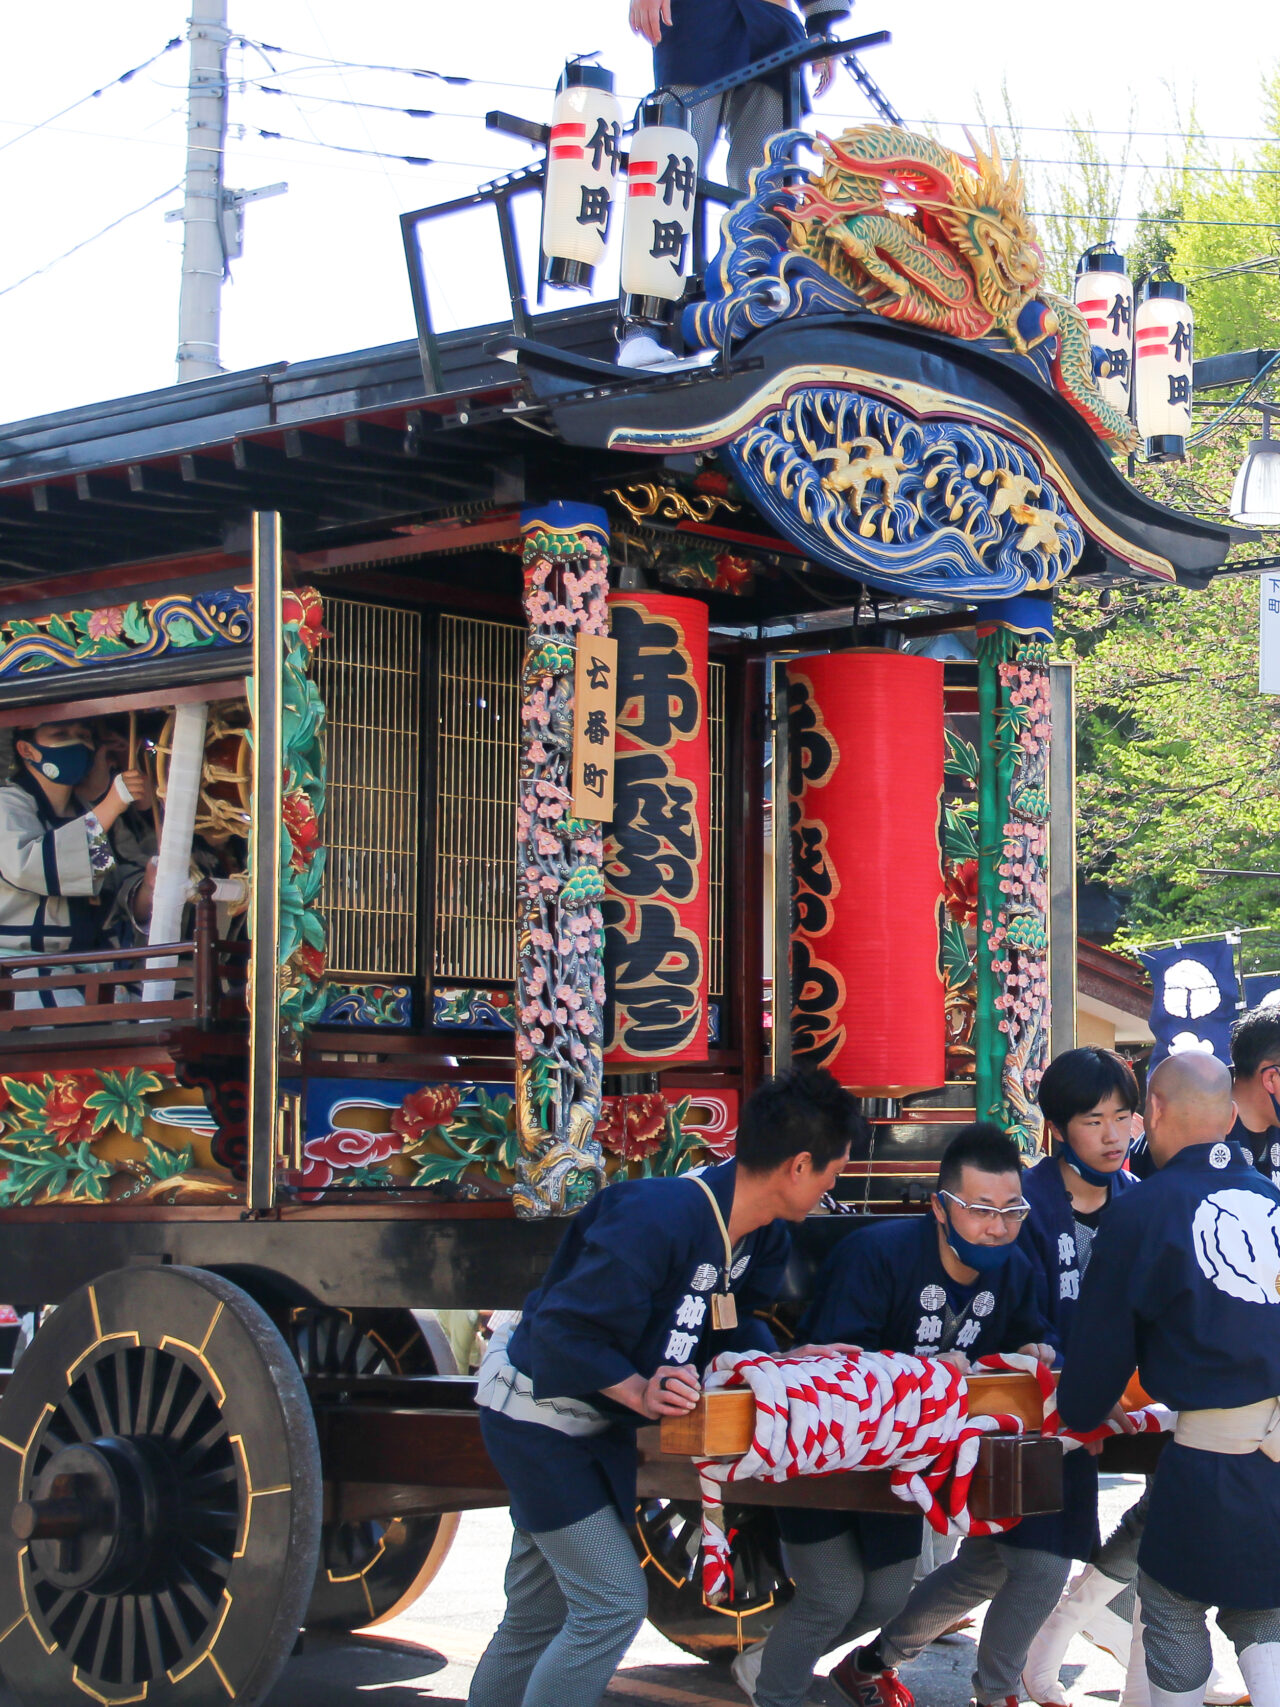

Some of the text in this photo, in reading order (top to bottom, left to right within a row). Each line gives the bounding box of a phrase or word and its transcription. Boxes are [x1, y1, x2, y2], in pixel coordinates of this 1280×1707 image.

[576, 117, 622, 245] 仲町
[649, 153, 696, 277] 仲町
[1104, 293, 1132, 394] 仲町
[1167, 321, 1192, 420] 仲町
[1268, 578, 1280, 614] 下町
[664, 1294, 707, 1364] 仲町
[858, 1685, 882, 1706] N
